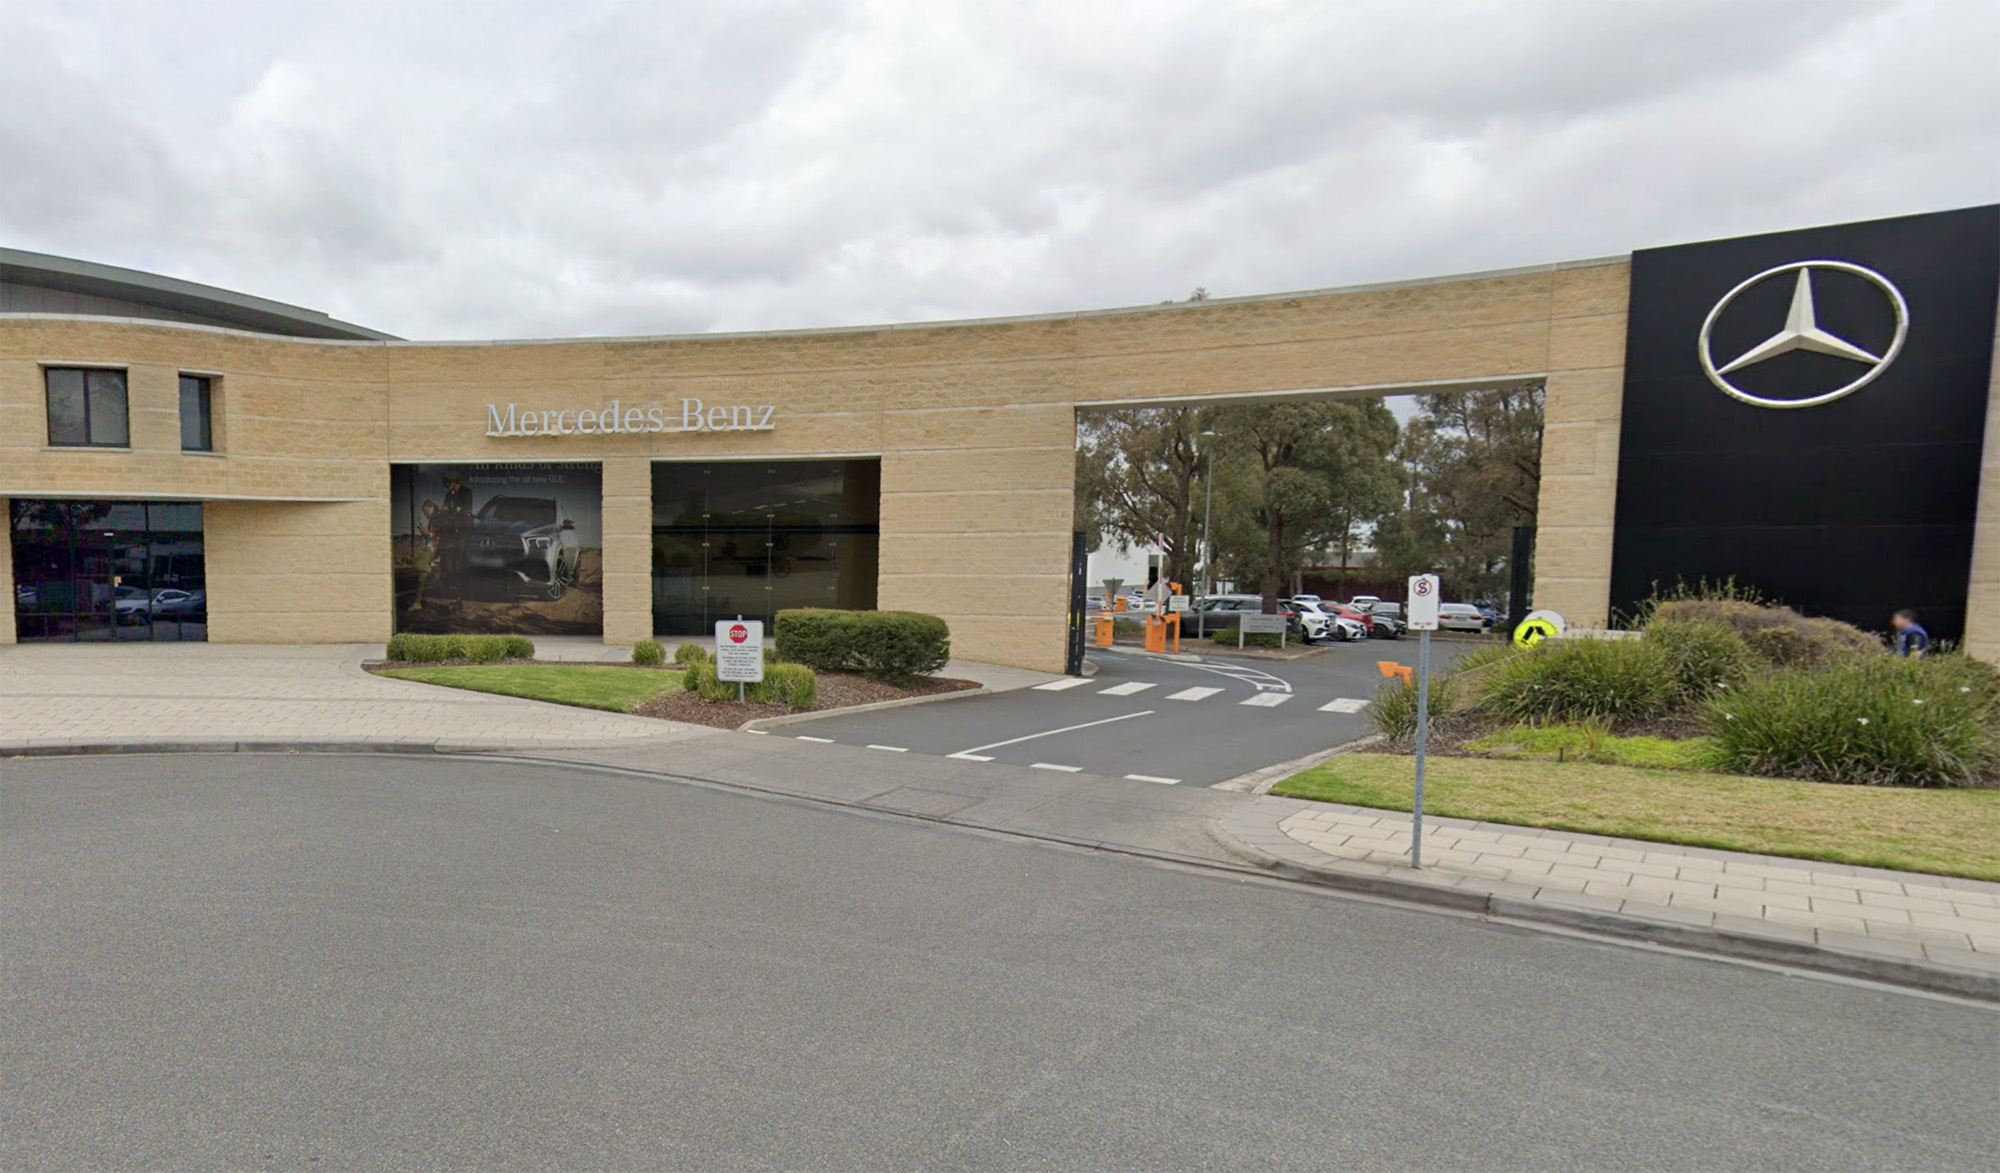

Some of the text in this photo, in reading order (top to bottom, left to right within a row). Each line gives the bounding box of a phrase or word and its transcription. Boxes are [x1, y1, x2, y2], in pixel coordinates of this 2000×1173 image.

[486, 397, 777, 436] Mercedes-Benz
[469, 475, 508, 485] Introducing
[509, 475, 520, 483] the
[730, 630, 747, 638] STOP
